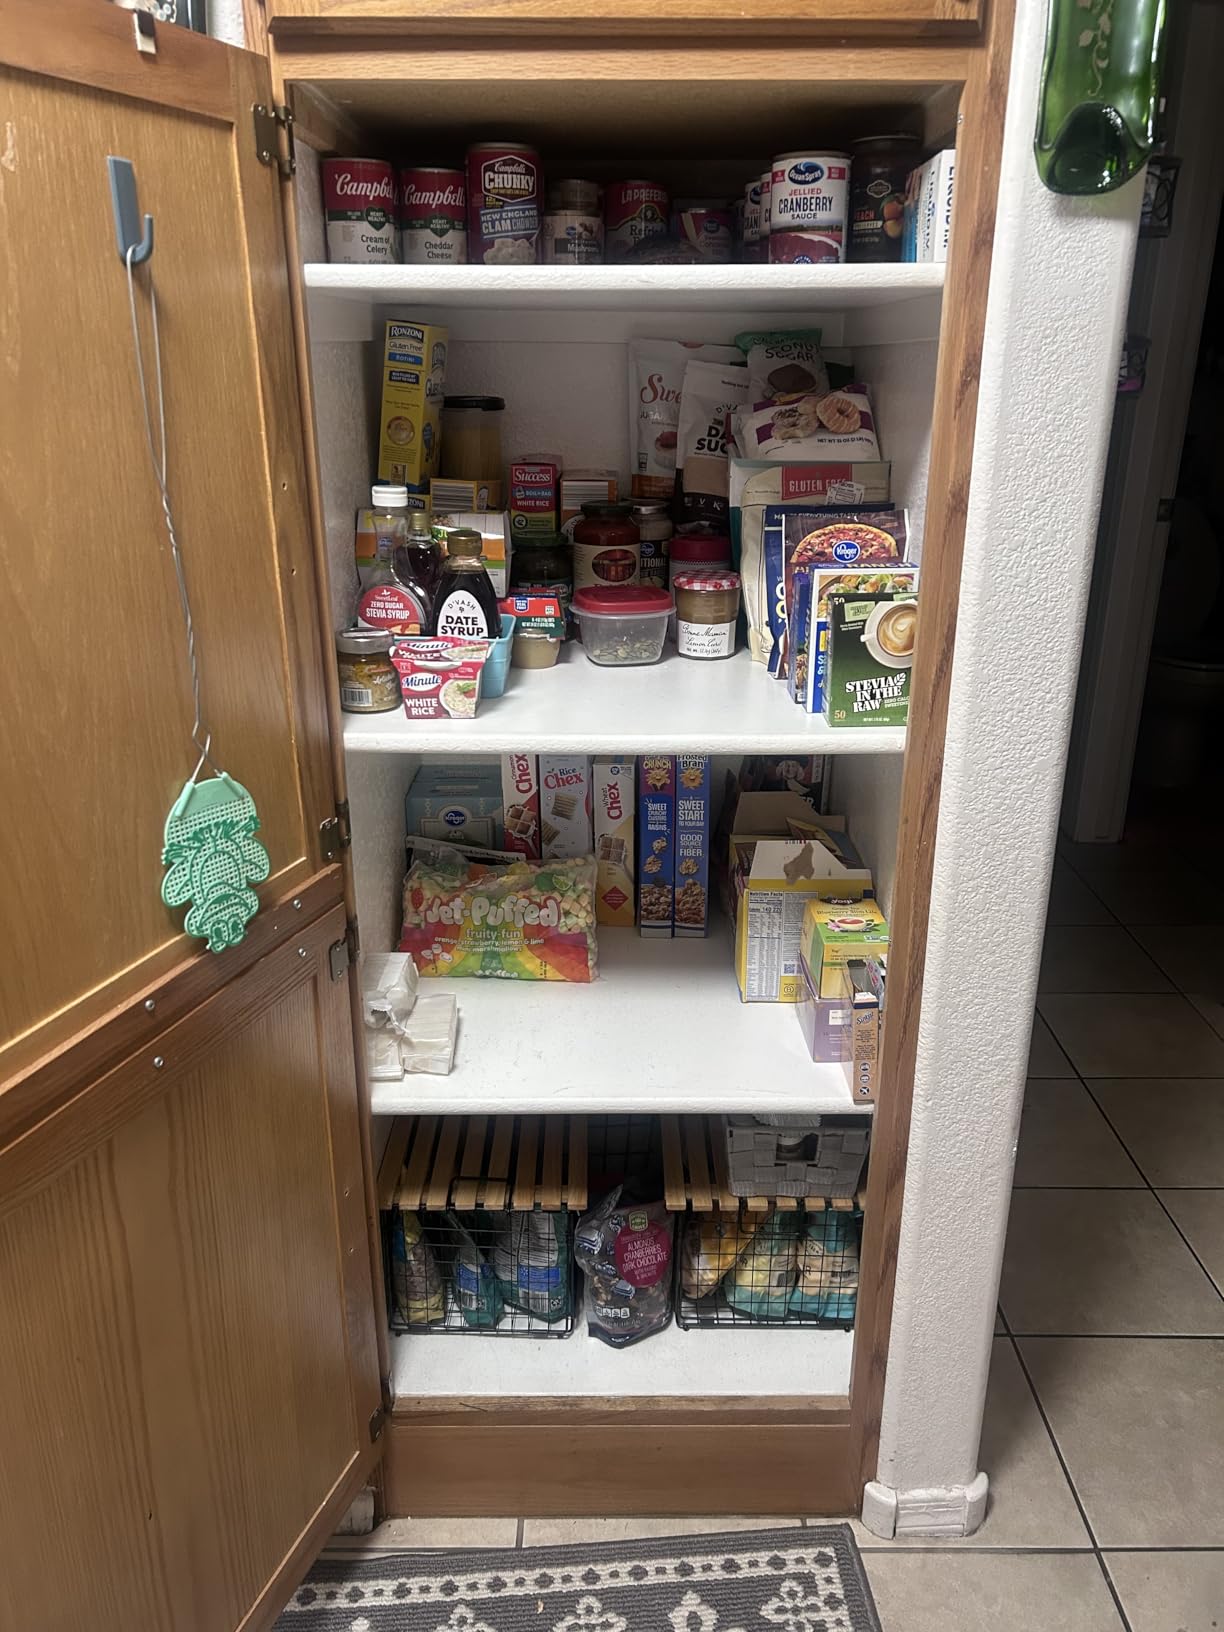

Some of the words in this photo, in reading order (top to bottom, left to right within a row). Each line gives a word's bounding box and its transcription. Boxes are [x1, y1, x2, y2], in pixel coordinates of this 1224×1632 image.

[485, 172, 534, 192] CHUNKY
[789, 188, 822, 196] JELLIED
[778, 197, 834, 214] CRANBERRY
[481, 213, 500, 222] NEW
[482, 219, 512, 233] CLAM
[361, 234, 385, 244] Cream
[366, 244, 388, 255] Celery
[424, 241, 453, 251] Cheddar
[427, 251, 452, 259] Cheese
[390, 325, 423, 339] RONZONI
[514, 470, 550, 482] Success
[789, 480, 822, 492] GLUTEN
[836, 544, 858, 559] Kroger
[449, 600, 477, 611] D'VASH
[366, 609, 387, 618] STEVIA
[388, 609, 410, 619] SYRUP
[445, 615, 478, 626] DATE
[441, 625, 484, 636] SYRUP
[402, 674, 442, 687] Minute
[845, 675, 895, 693] STEVIA
[856, 690, 871, 702] IN
[872, 685, 902, 700] THE
[405, 698, 439, 708] WHITE
[853, 699, 881, 713] RAW
[411, 707, 436, 716] RICE
[834, 710, 846, 719] 50
[643, 759, 672, 769] CRUNCH
[681, 760, 704, 769] Bran
[514, 754, 533, 794] Chex
[558, 767, 577, 776] Rice
[543, 771, 584, 790] Chex
[601, 787, 609, 808] Wheat
[607, 781, 623, 820] Chex
[678, 800, 704, 811] SWEET
[678, 810, 705, 821] START
[680, 834, 703, 842] GOOD
[679, 848, 702, 857] FIBER
[426, 895, 560, 928] Jet-Puffed
[627, 1236, 655, 1252] ALMONDS
[623, 1243, 662, 1262] CRANBERRIES
[636, 1251, 669, 1269] CHOCOLATE
